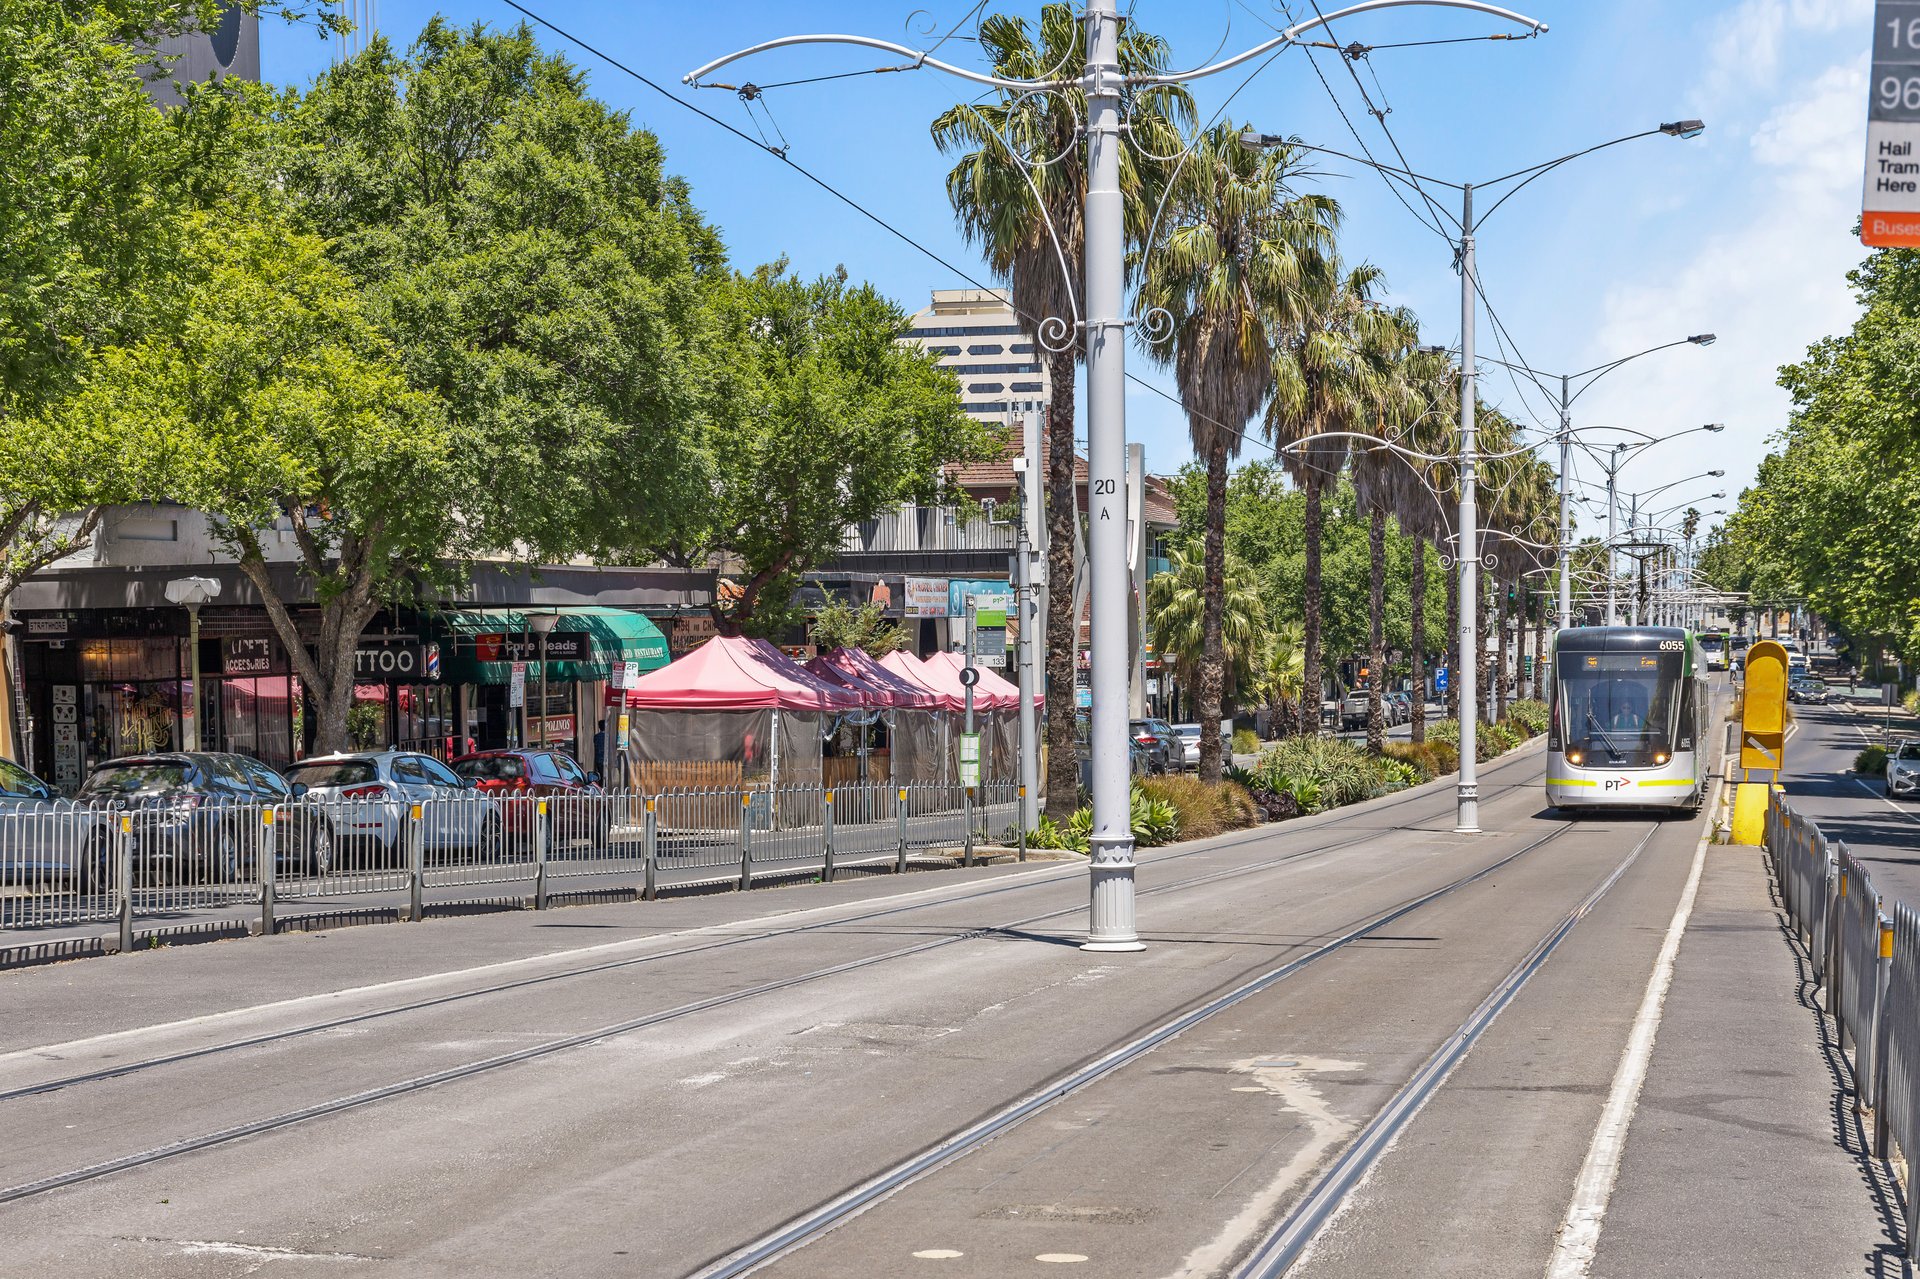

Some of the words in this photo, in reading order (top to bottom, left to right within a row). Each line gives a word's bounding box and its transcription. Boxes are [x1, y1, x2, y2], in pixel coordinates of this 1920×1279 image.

[1887, 17, 1920, 50] 16
[1880, 76, 1920, 110] 96
[1879, 141, 1911, 156] Hail
[1878, 159, 1919, 174] Tram
[1877, 178, 1917, 193] Here
[1094, 479, 1115, 495] 20
[1100, 506, 1110, 520] A
[703, 619, 716, 631] CHI
[1659, 640, 1684, 650] 6055
[226, 658, 269, 671] ACCESSORIES
[355, 650, 413, 672] TTOO
[1436, 669, 1444, 680] P
[537, 719, 570, 733] TPOLINOS
